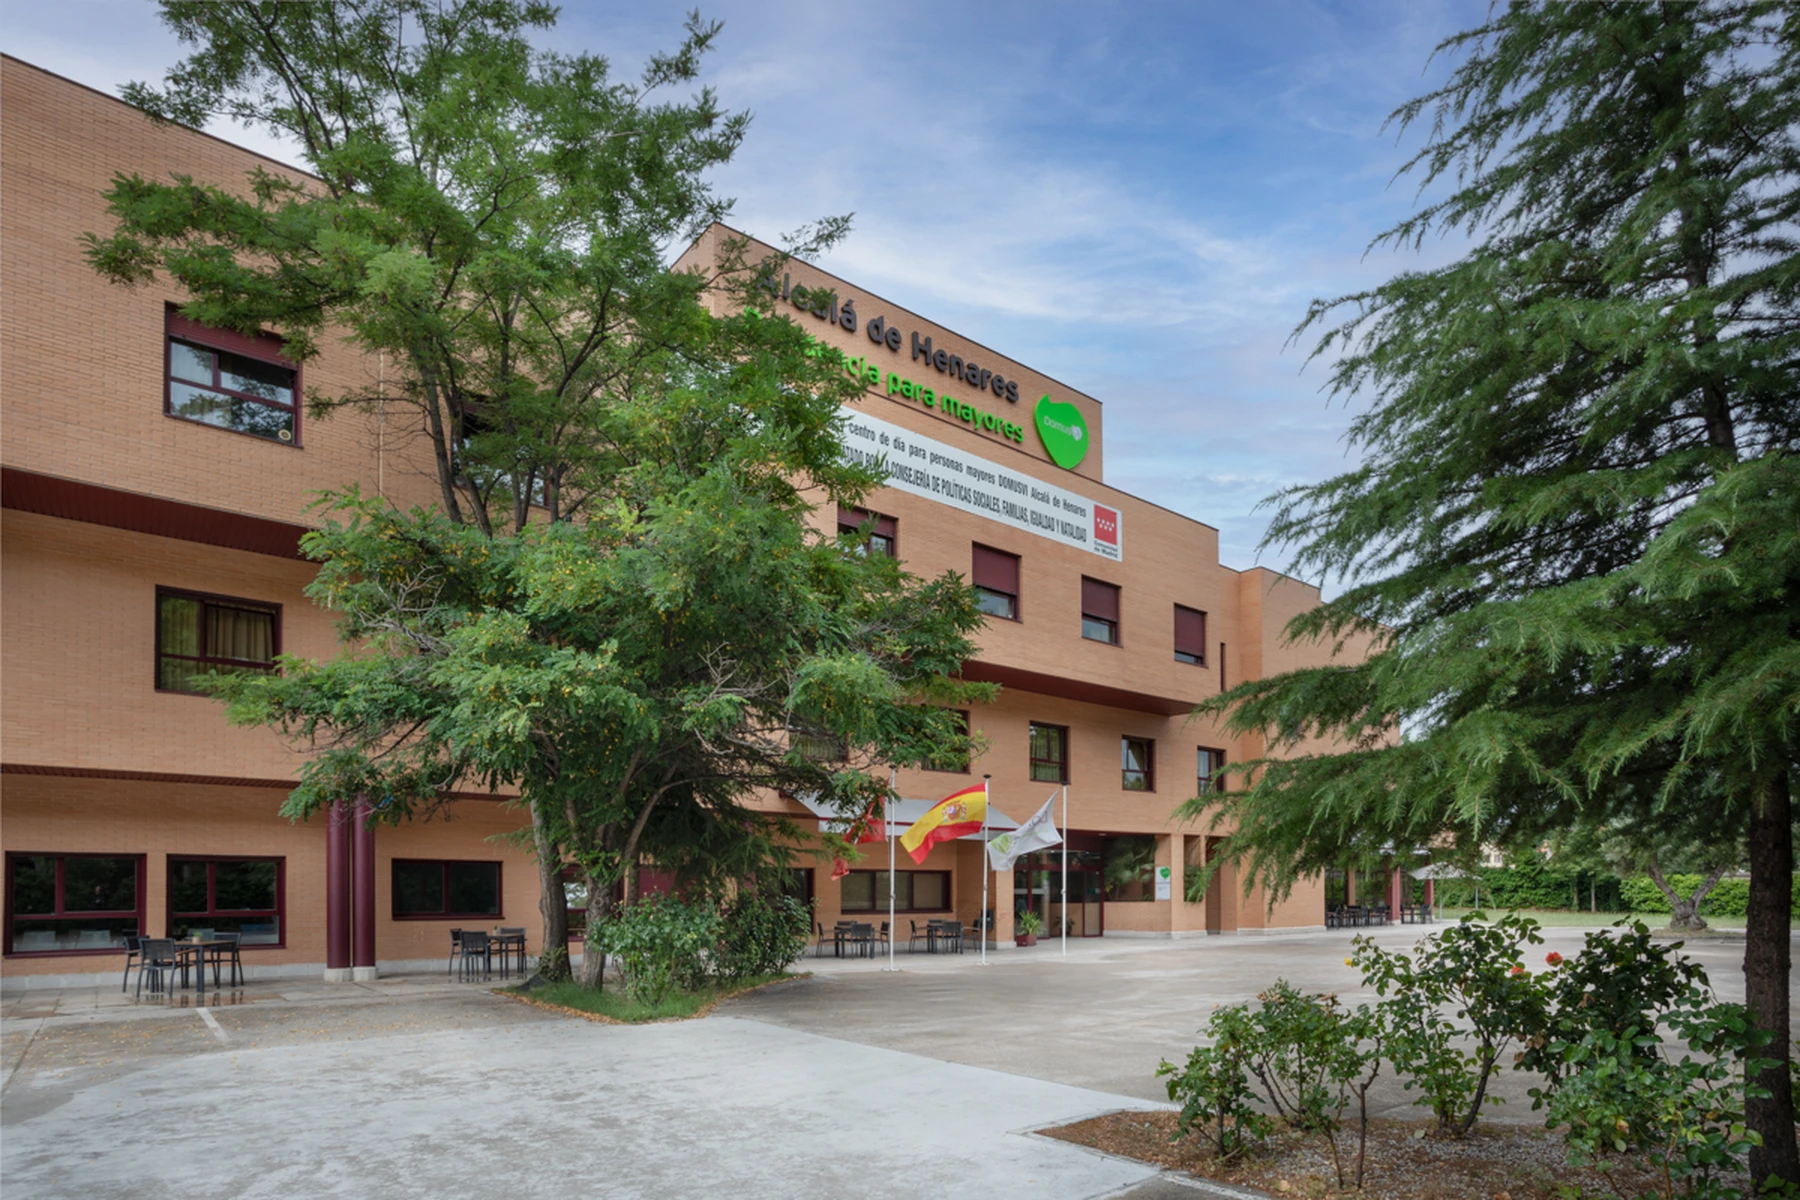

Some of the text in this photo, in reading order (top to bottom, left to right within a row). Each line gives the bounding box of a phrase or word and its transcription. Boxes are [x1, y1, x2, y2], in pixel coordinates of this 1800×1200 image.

[867, 315, 902, 351] de
[911, 331, 1019, 403] Henares
[887, 371, 1024, 443] para mayores
[848, 422, 876, 441] centro
[879, 431, 890, 447] de
[908, 444, 927, 460] para
[929, 452, 964, 473] personas
[965, 464, 996, 484] mayores
[1030, 486, 1050, 504] Alcalá
[1052, 495, 1060, 508] de
[1063, 498, 1087, 518] Henares
[891, 461, 931, 490] CONSEJERÍA
[932, 475, 940, 493] DE
[941, 479, 972, 504] POLÍTICAS
[1030, 510, 1055, 532] IGUALDAD
[1056, 518, 1060, 533] Y
[1061, 520, 1087, 542] NATALIDAD
